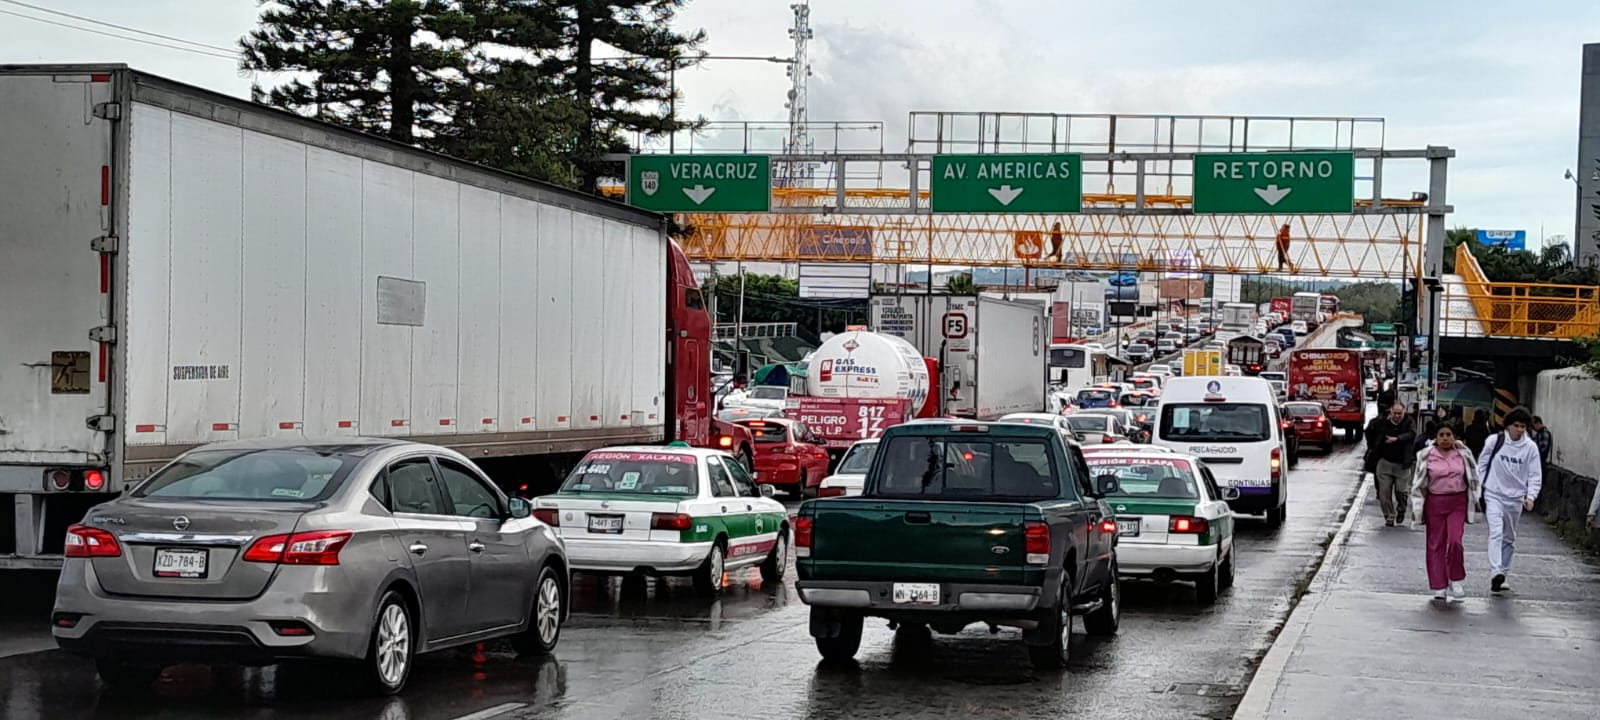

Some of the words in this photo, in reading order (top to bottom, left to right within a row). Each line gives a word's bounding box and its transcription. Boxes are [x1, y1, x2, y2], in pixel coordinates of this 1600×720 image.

[670, 162, 758, 179] VERACRUZ
[944, 162, 969, 180] AV.
[977, 161, 1070, 180] AMERICAS
[1213, 161, 1333, 179] RETORNO
[947, 320, 963, 332] F5
[173, 365, 208, 380] SUSPENSION
[209, 365, 216, 379] DE
[834, 365, 877, 374] EXPRESS
[858, 406, 885, 417] 817
[801, 415, 847, 425] PELIGRO
[1132, 459, 1174, 467] XALAPA
[1228, 480, 1271, 488] CONTINUAS
